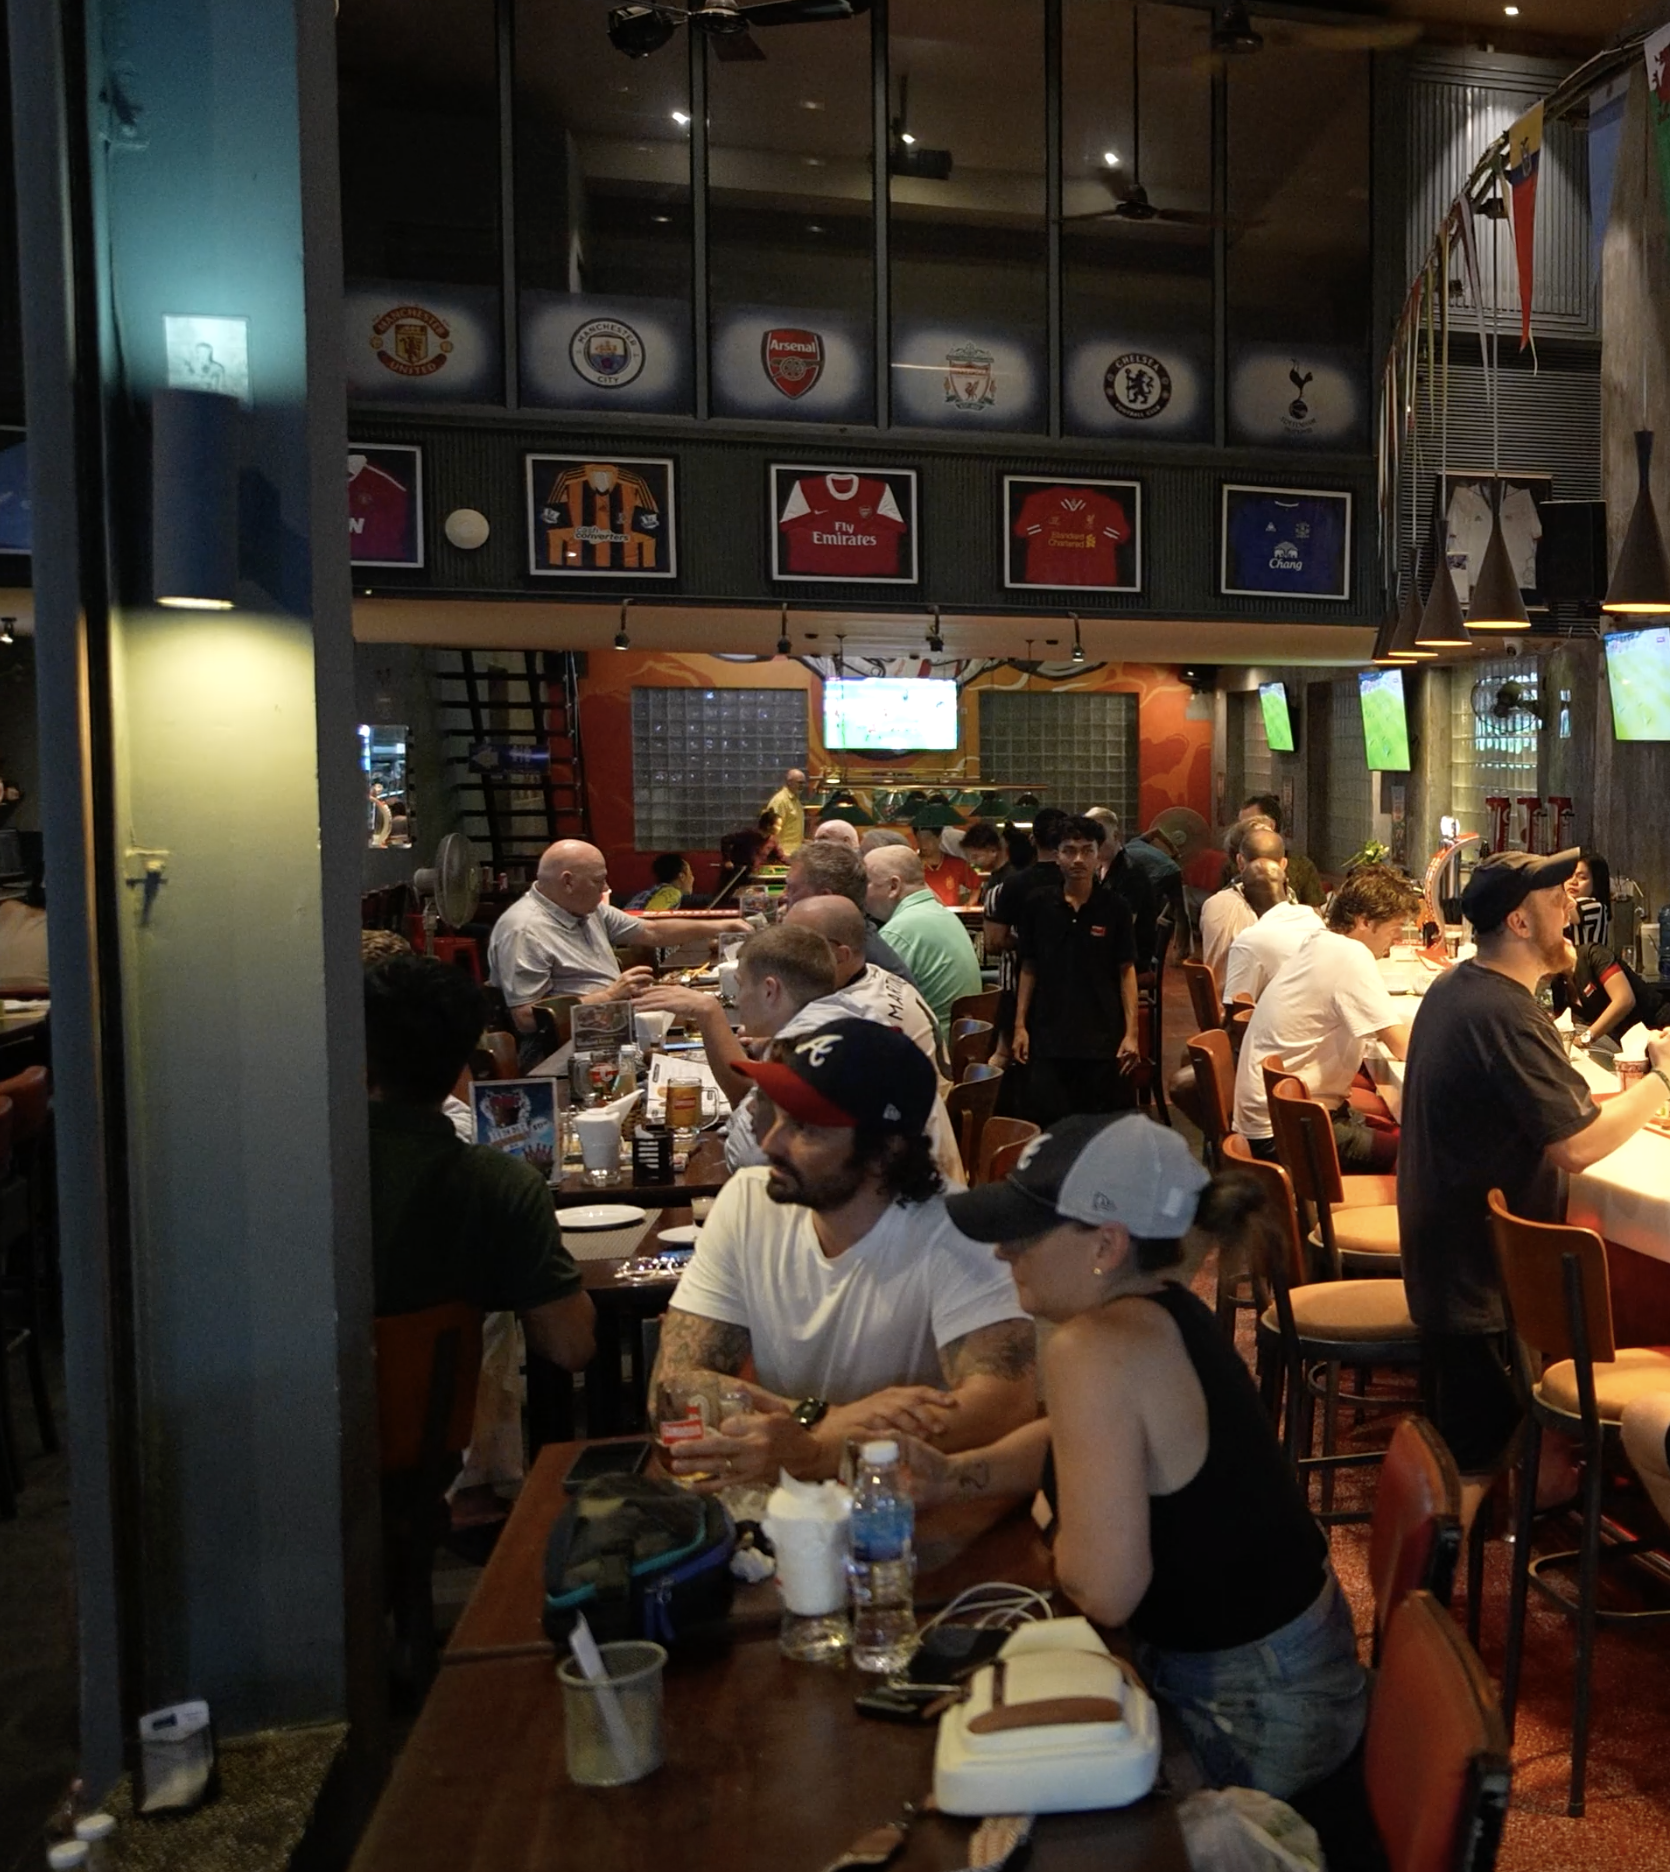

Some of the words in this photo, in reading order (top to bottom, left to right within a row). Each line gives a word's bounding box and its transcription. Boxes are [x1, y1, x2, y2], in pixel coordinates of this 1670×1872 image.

[377, 307, 448, 337] MANCHESTER
[577, 322, 637, 348] MANCHESTER
[770, 338, 815, 353] Arsenal
[390, 360, 437, 375] UNITED
[1115, 354, 1161, 371] CHELSEA
[597, 375, 620, 385] CITY
[576, 525, 599, 534] cash
[835, 521, 854, 534] Fly
[574, 532, 629, 544] converters
[812, 532, 877, 546] Emirates
[1051, 531, 1085, 541] Standard
[1048, 539, 1085, 549] Chartered
[1269, 558, 1303, 571] Chang
[795, 1035, 843, 1067] A
